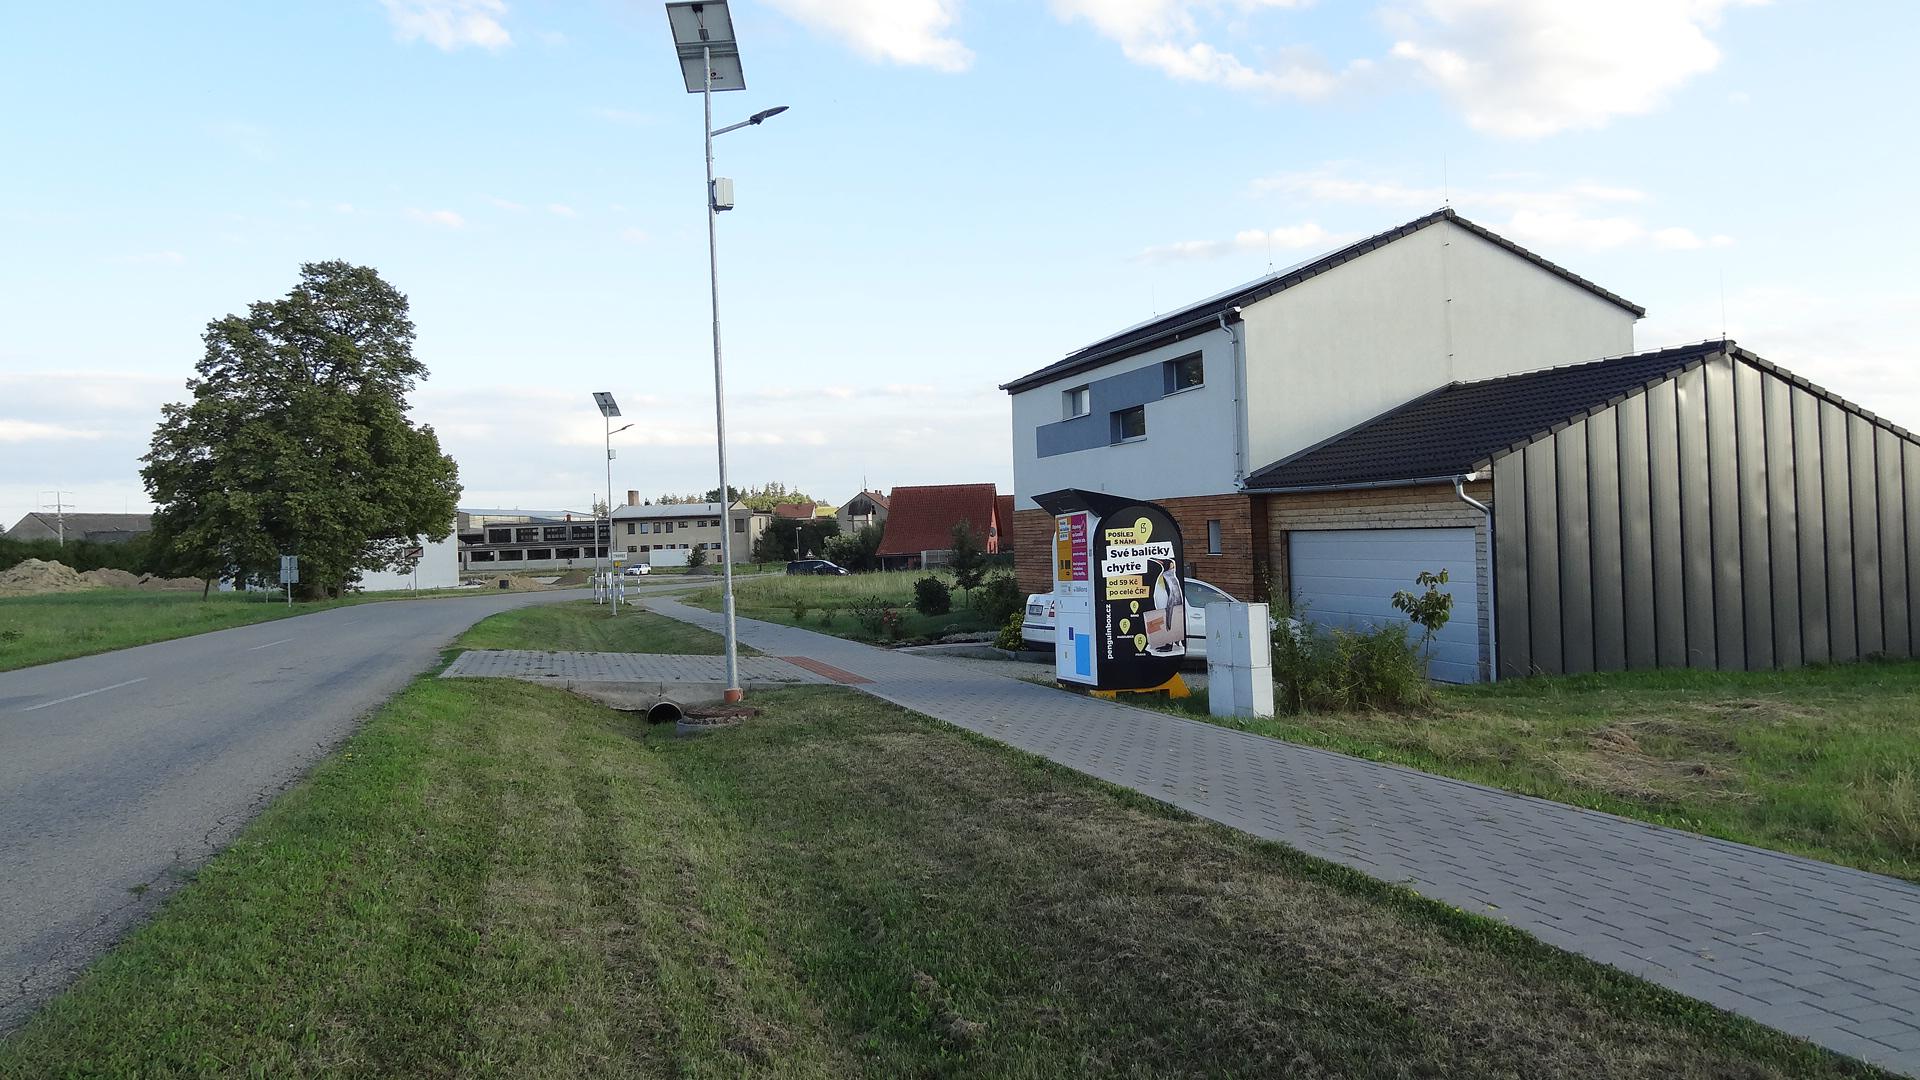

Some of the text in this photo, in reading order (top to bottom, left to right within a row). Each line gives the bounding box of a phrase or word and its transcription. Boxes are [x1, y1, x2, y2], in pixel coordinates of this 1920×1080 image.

[1110, 549, 1130, 558] Své
[1107, 562, 1141, 573] chytře
[1105, 604, 1114, 659] penguinbox.cz
